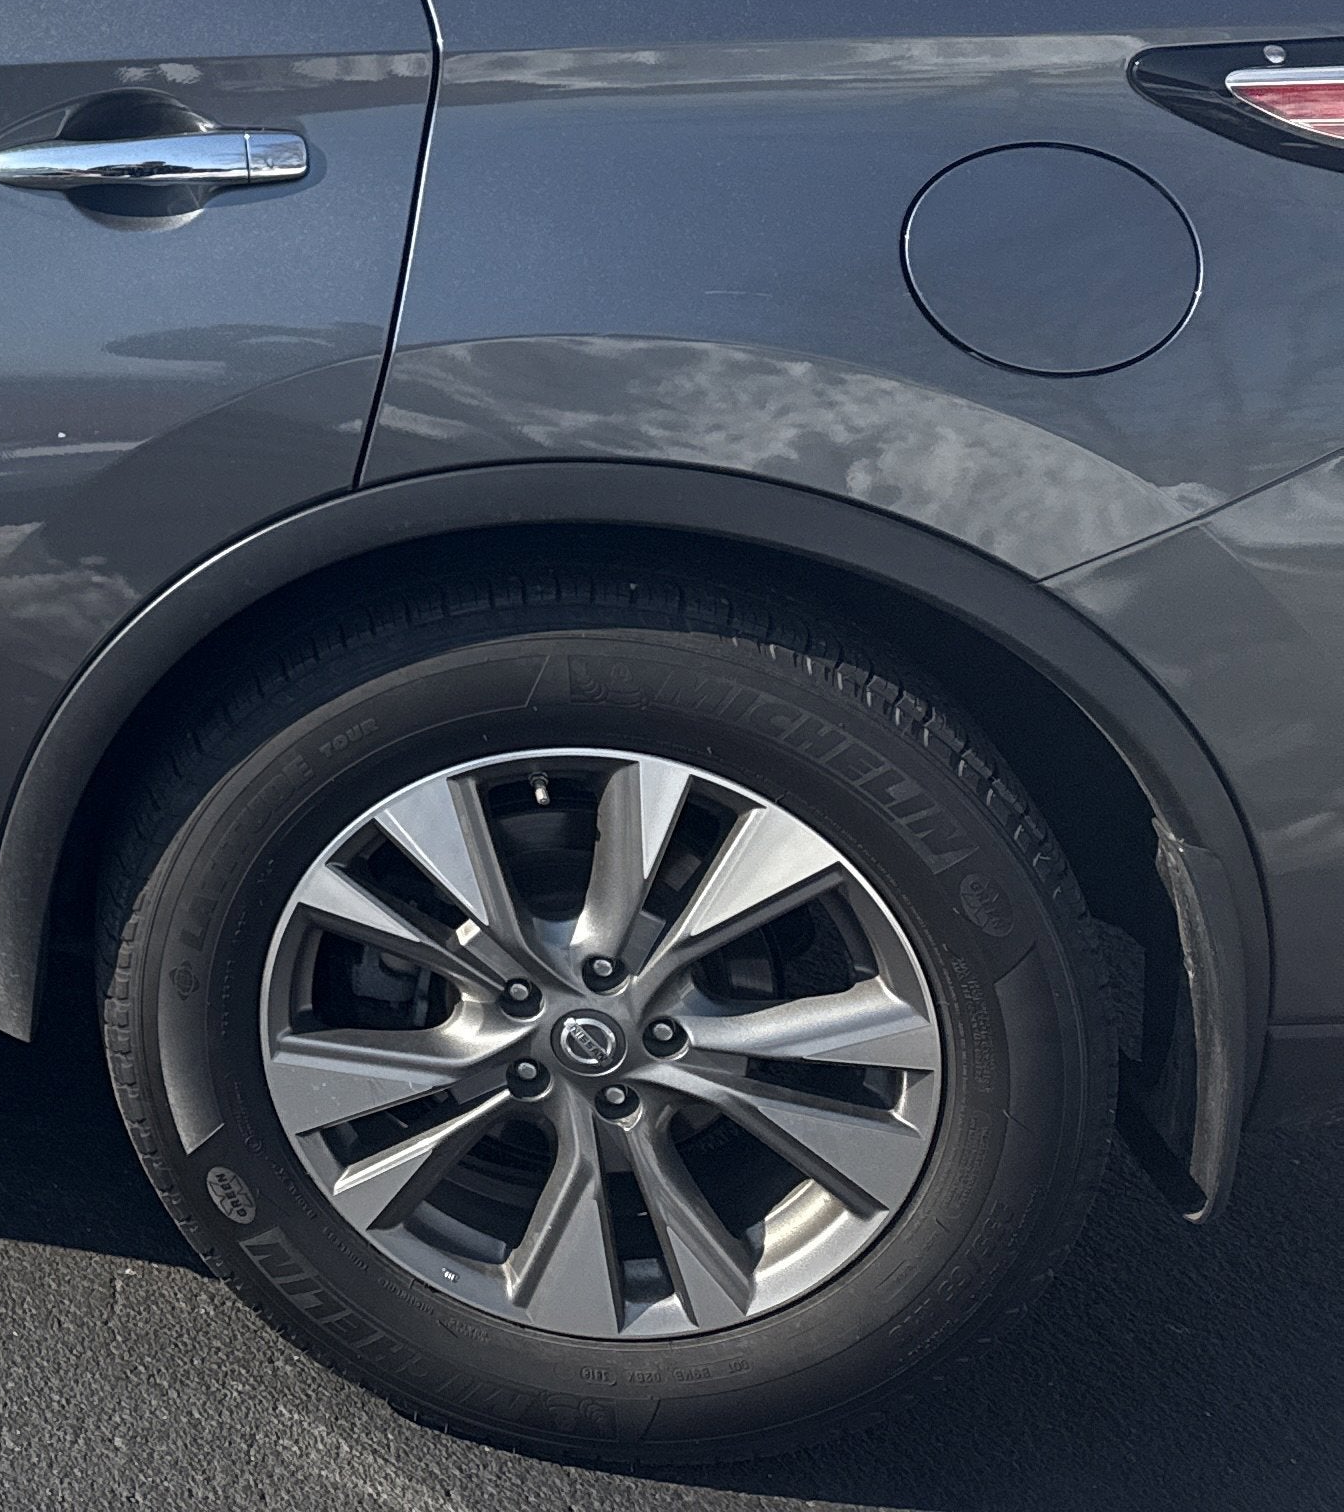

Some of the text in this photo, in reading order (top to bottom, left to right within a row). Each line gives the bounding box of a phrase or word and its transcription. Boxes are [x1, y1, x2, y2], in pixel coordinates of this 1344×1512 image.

[318, 717, 379, 759] TOUR
[653, 668, 970, 861] MICHELIN
[215, 1170, 248, 1219] GREEN
[246, 1233, 527, 1416] MICHELIN
